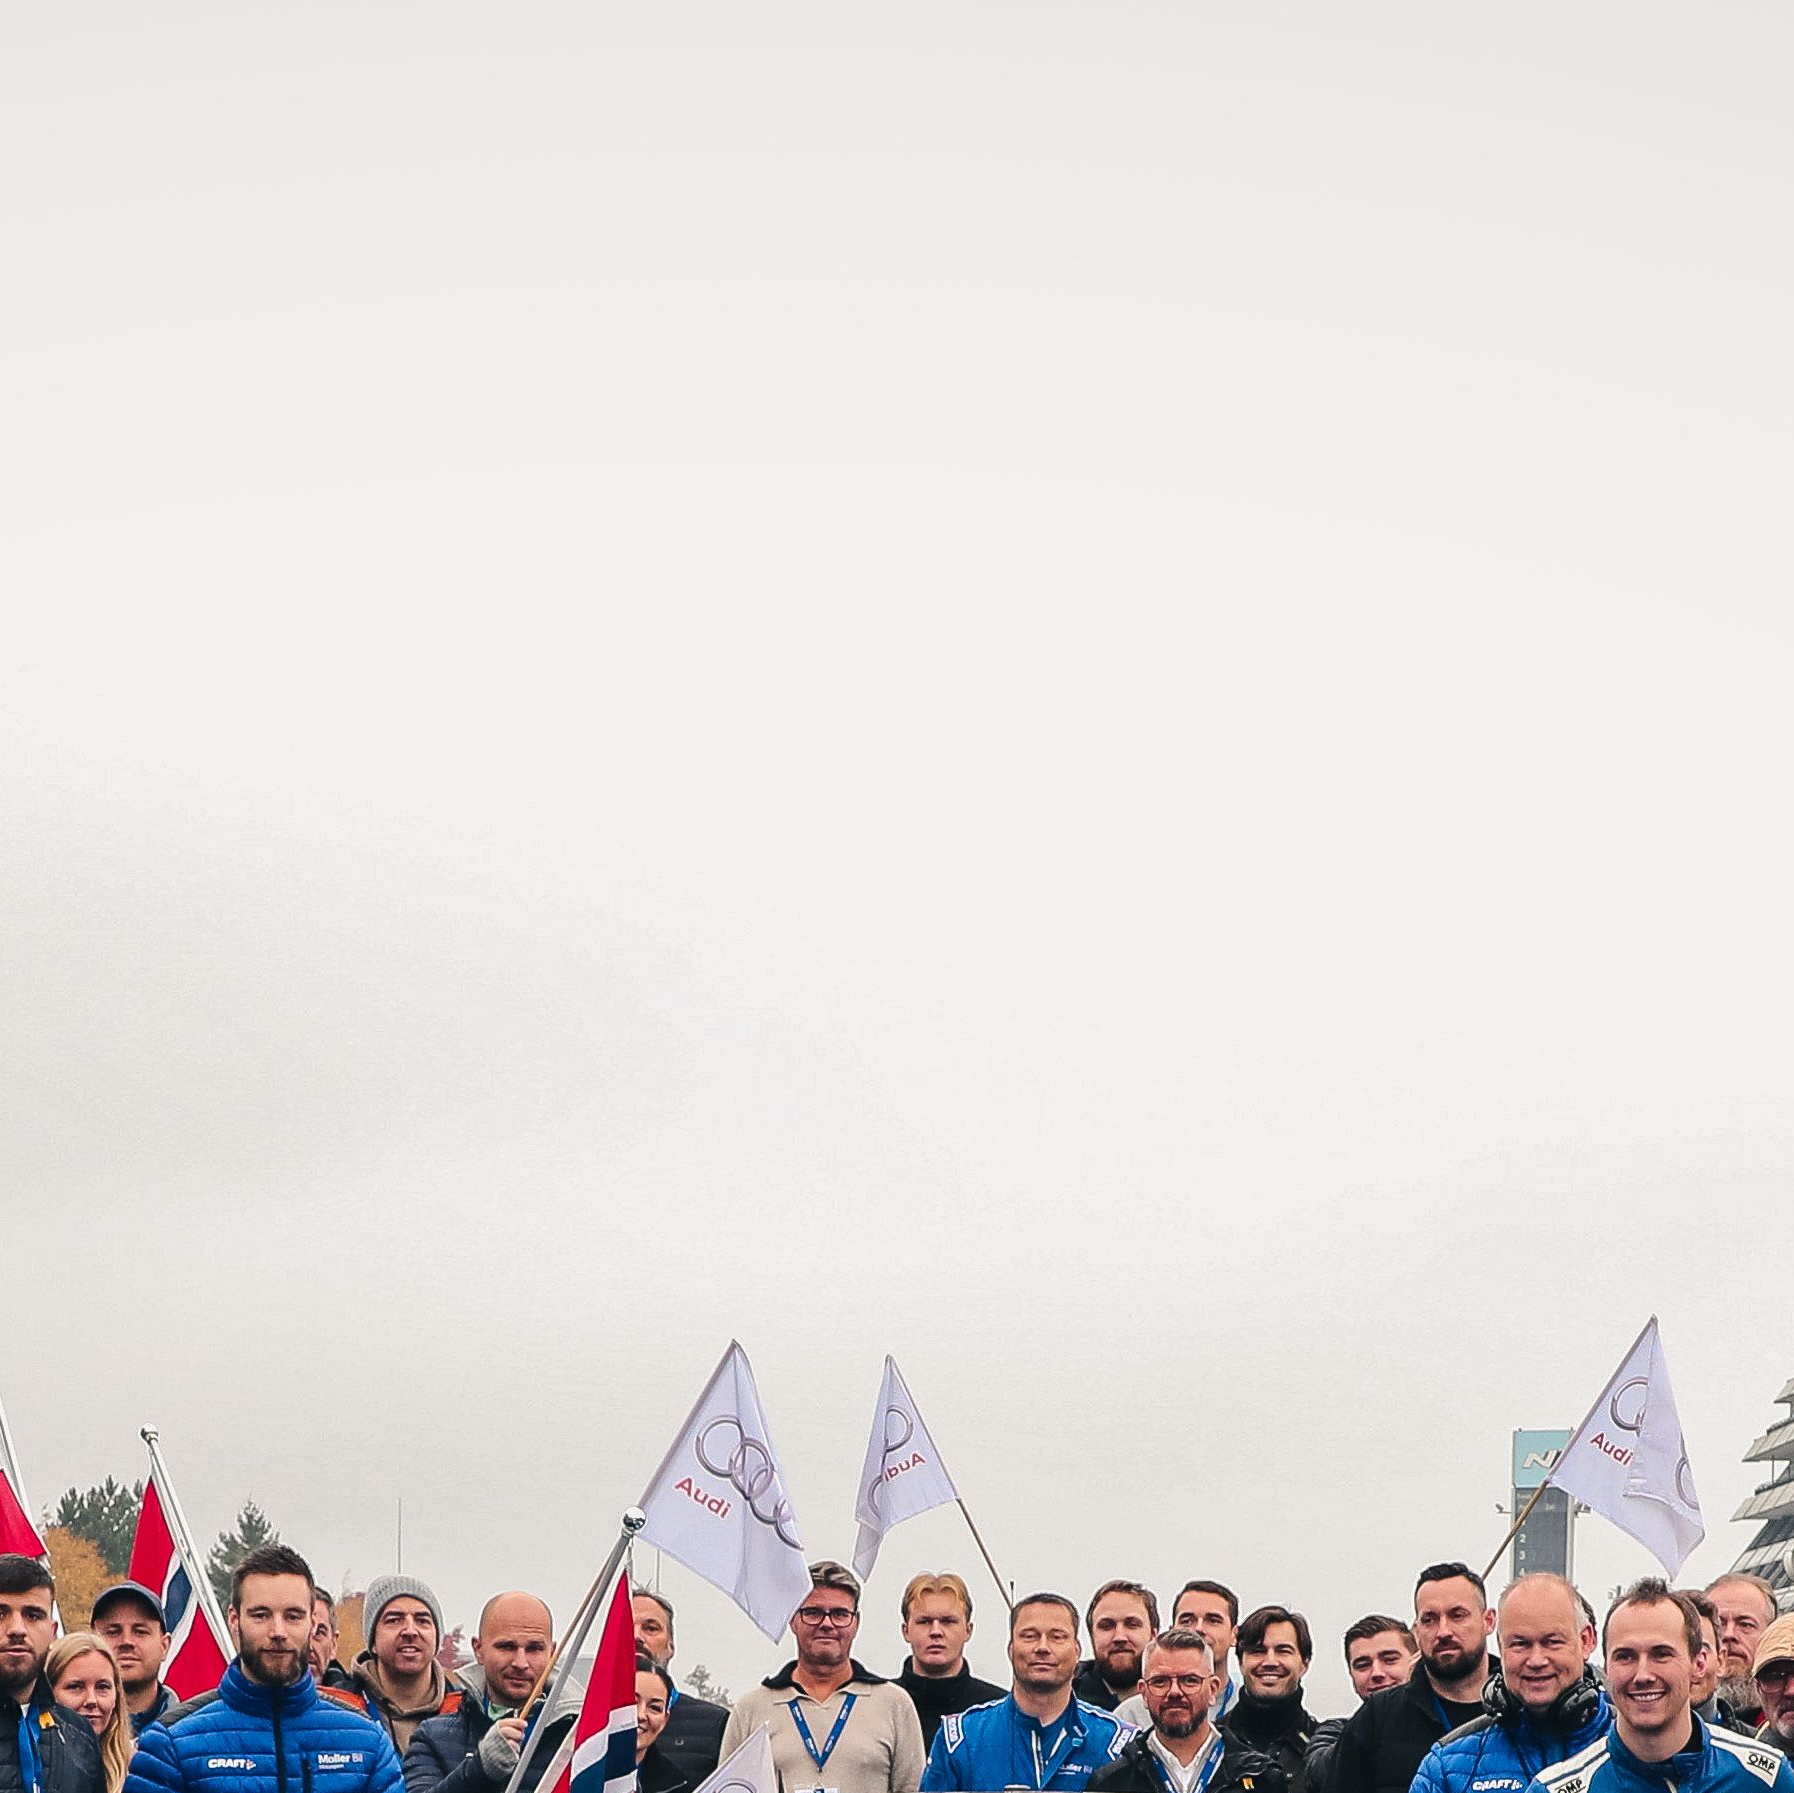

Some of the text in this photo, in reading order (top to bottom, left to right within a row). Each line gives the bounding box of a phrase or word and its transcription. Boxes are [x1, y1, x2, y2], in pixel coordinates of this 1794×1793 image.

[1589, 1431, 1634, 1466] Audi
[674, 1477, 732, 1518] Audi
[207, 1758, 246, 1770] CRAFT
[1748, 1754, 1775, 1771] OMP
